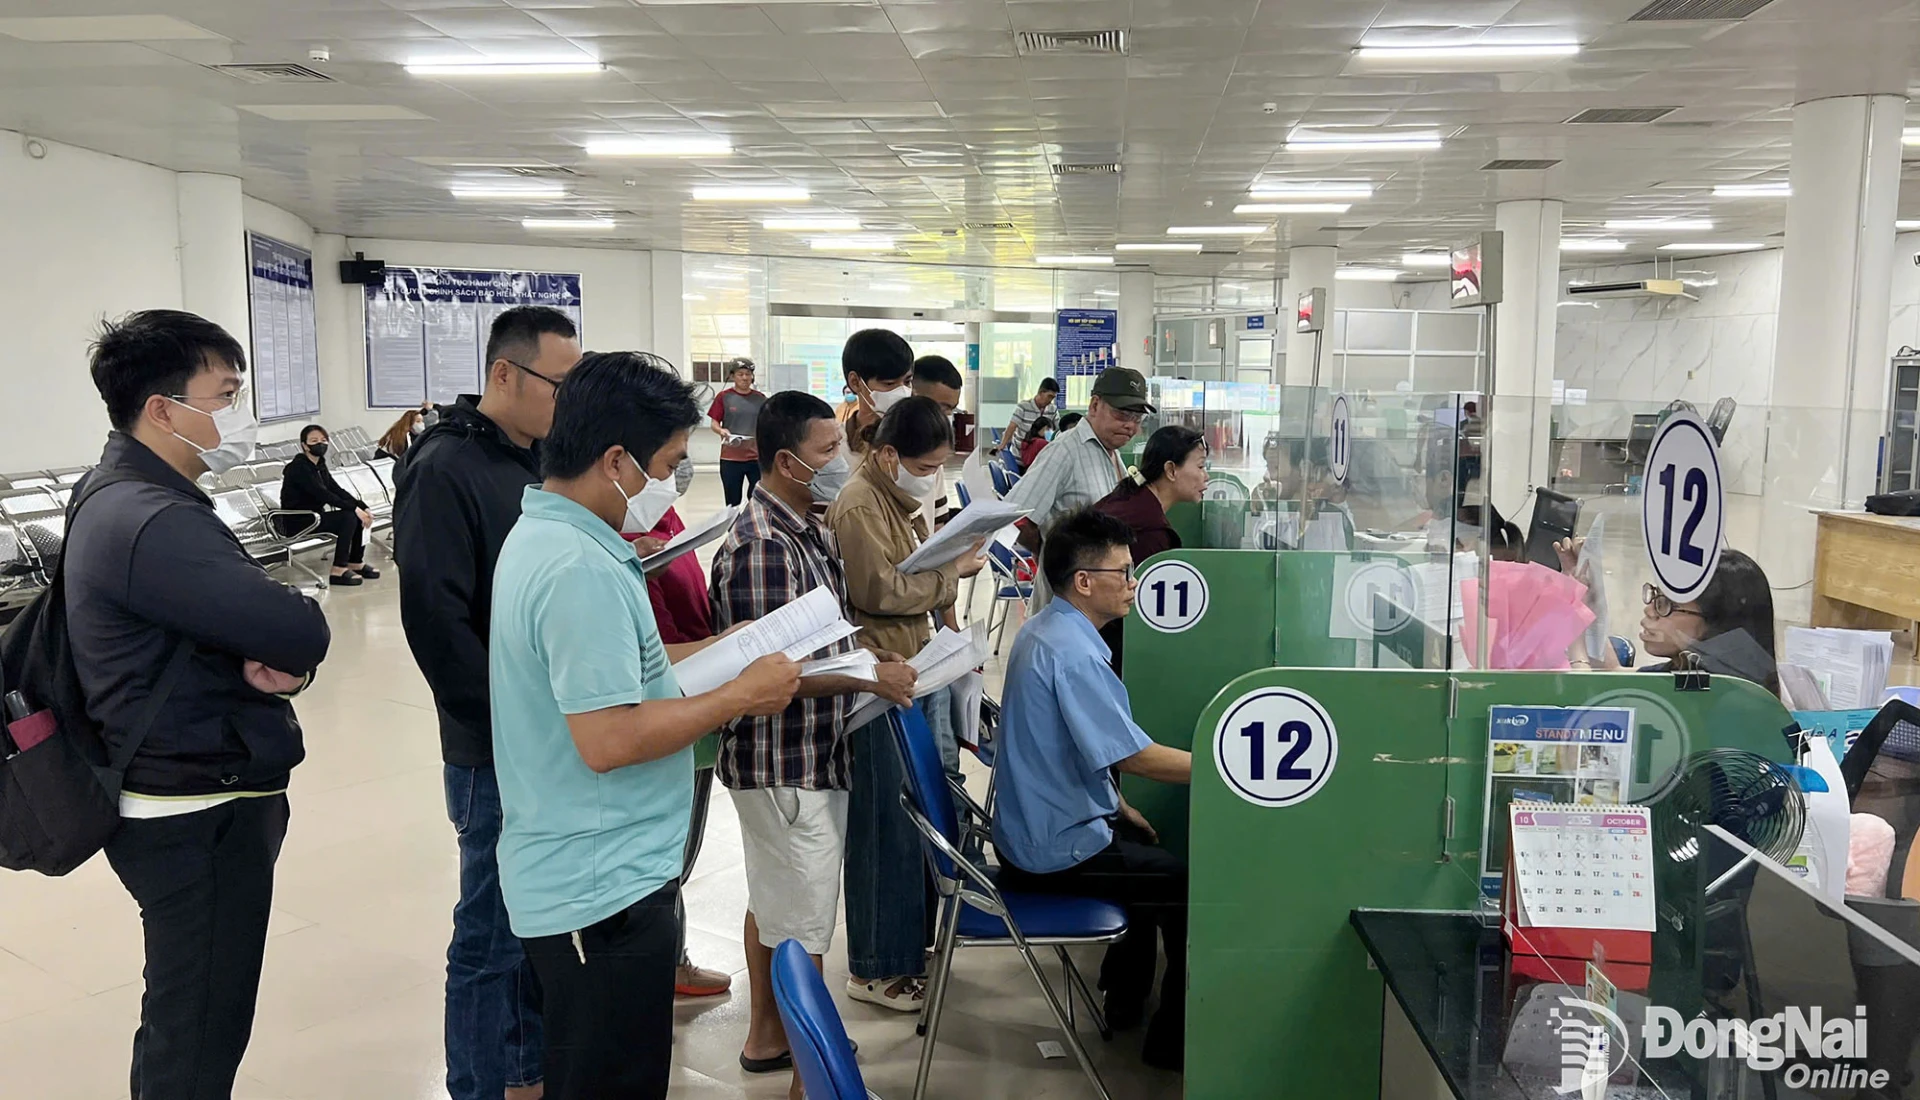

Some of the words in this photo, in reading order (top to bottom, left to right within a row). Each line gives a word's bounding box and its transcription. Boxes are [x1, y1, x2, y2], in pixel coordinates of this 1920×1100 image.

[455, 287, 476, 296] SÁCH
[478, 287, 495, 297] BẢO
[1334, 418, 1346, 466] 11
[1659, 463, 1708, 567] 12
[1151, 580, 1188, 617] 11
[1240, 720, 1312, 780] 12
[1536, 729, 1578, 739] STANDY
[1580, 729, 1624, 740] MENU
[1520, 816, 1528, 824] 10
